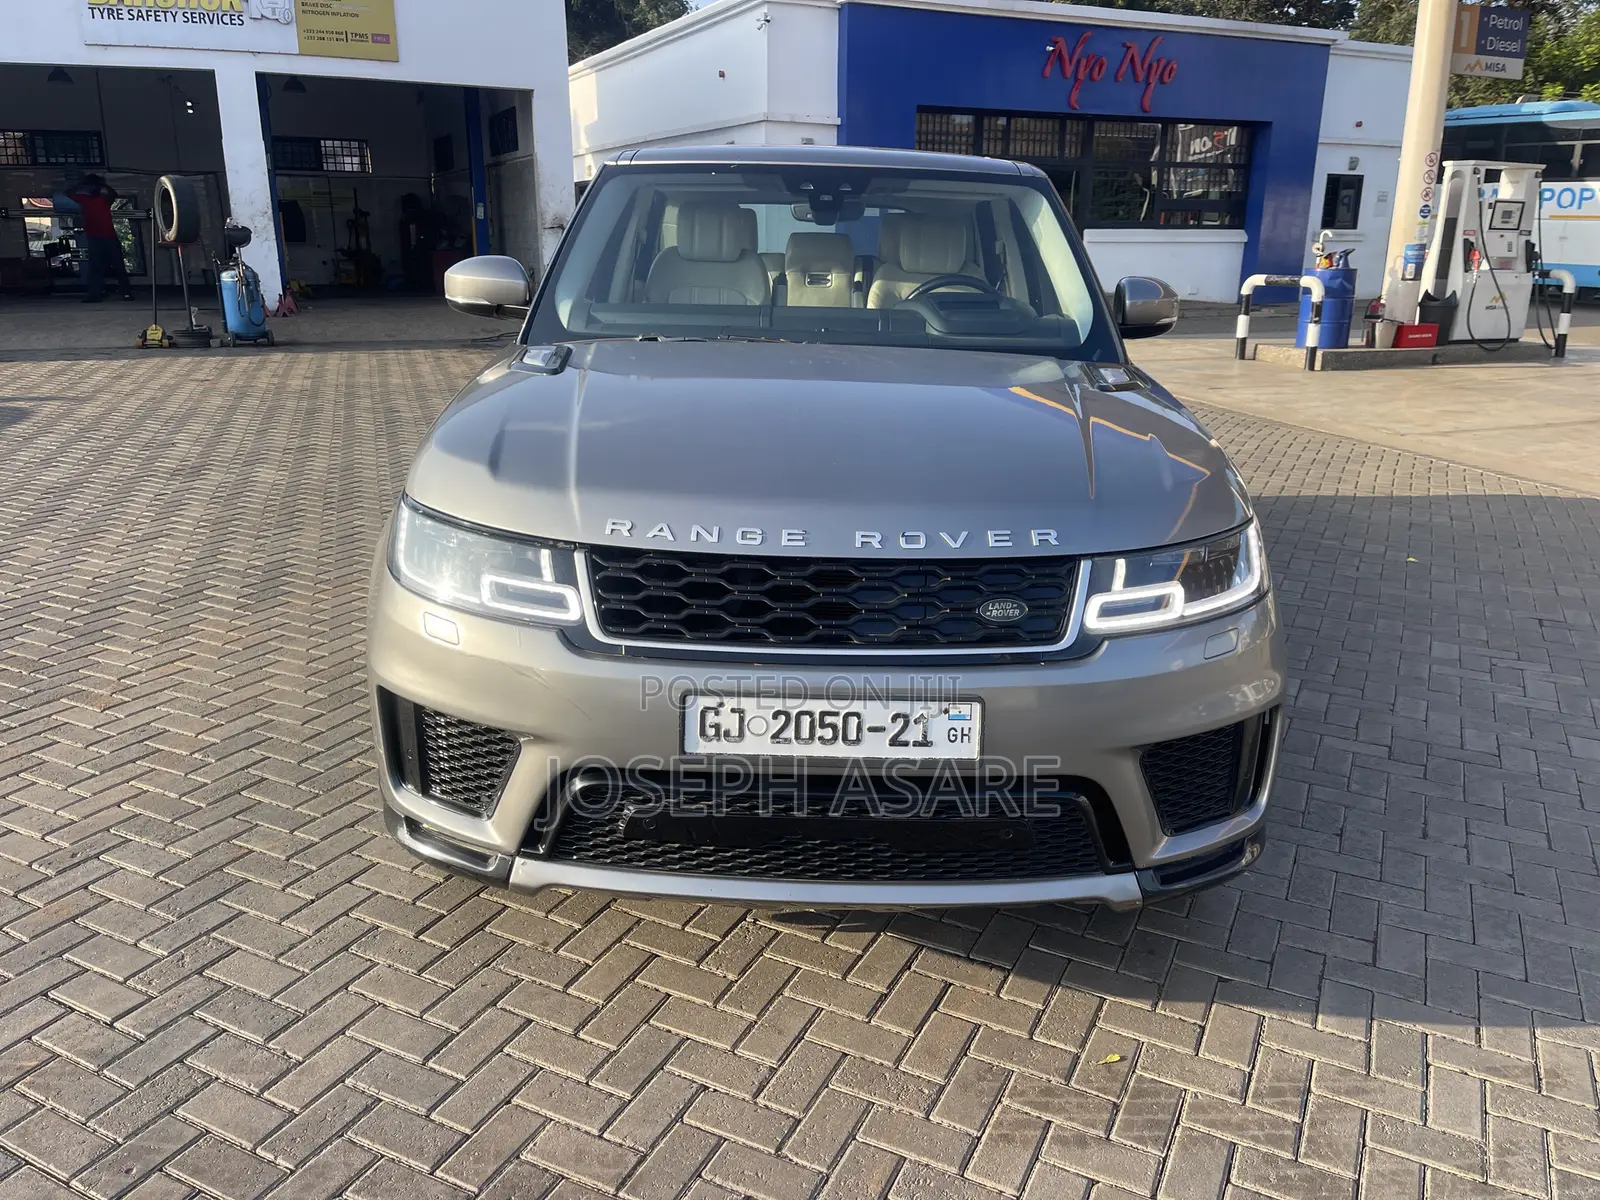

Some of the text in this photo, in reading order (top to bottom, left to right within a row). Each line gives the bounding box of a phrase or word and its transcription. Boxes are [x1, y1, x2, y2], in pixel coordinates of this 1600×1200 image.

[88, 6, 124, 20] TYRE
[127, 8, 178, 23] SAFETY
[182, 11, 245, 27] SERVICES
[1489, 14, 1524, 31] Petrol
[350, 32, 369, 40] TPMS
[1486, 36, 1522, 53] Diesel
[1042, 30, 1178, 113] Nyo Nyo
[1484, 61, 1507, 73] MISA
[604, 517, 1060, 550] RANGE ROVER
[988, 601, 1012, 610] LAND
[991, 608, 1020, 617] ROVER
[697, 705, 933, 748] GJ 2050-21
[946, 725, 973, 744] GH
